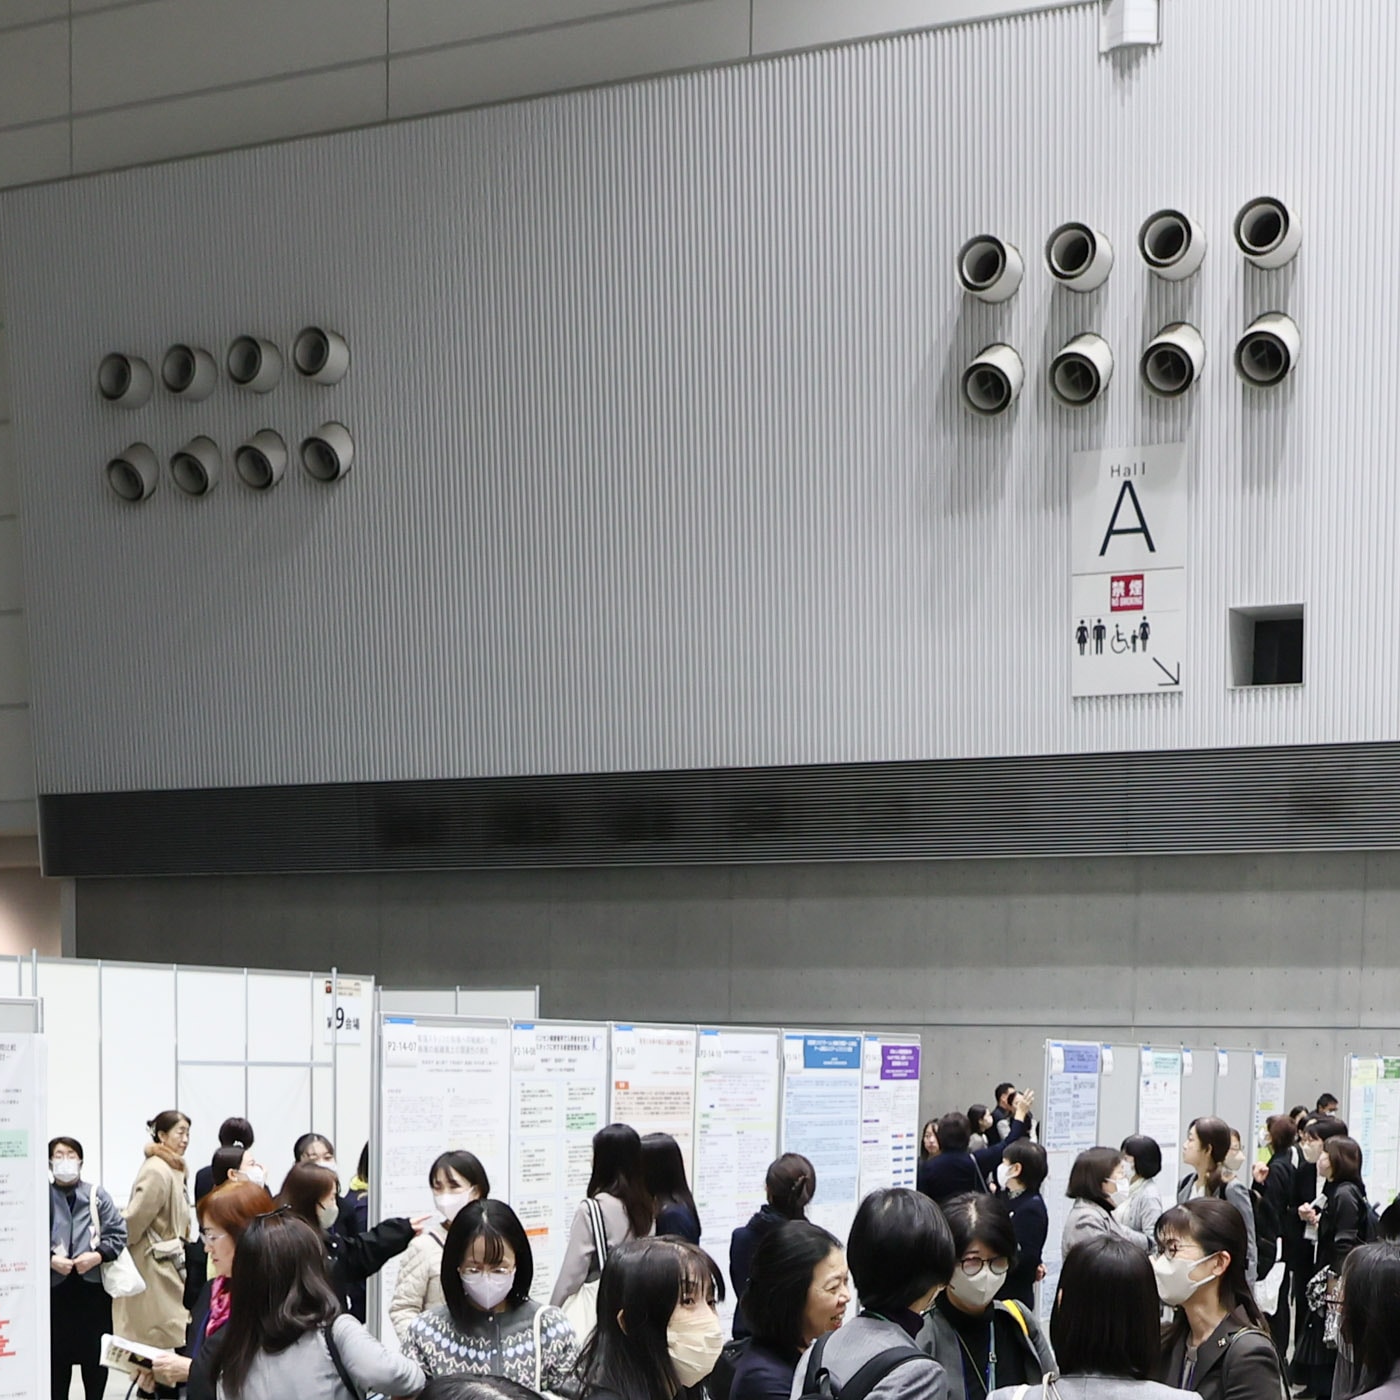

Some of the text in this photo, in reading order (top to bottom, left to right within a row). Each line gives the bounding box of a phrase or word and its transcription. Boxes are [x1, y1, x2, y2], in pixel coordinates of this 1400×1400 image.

[1110, 461, 1146, 478] Hall
[1099, 480, 1156, 557] A
[388, 1040, 417, 1052] P2-14-07
